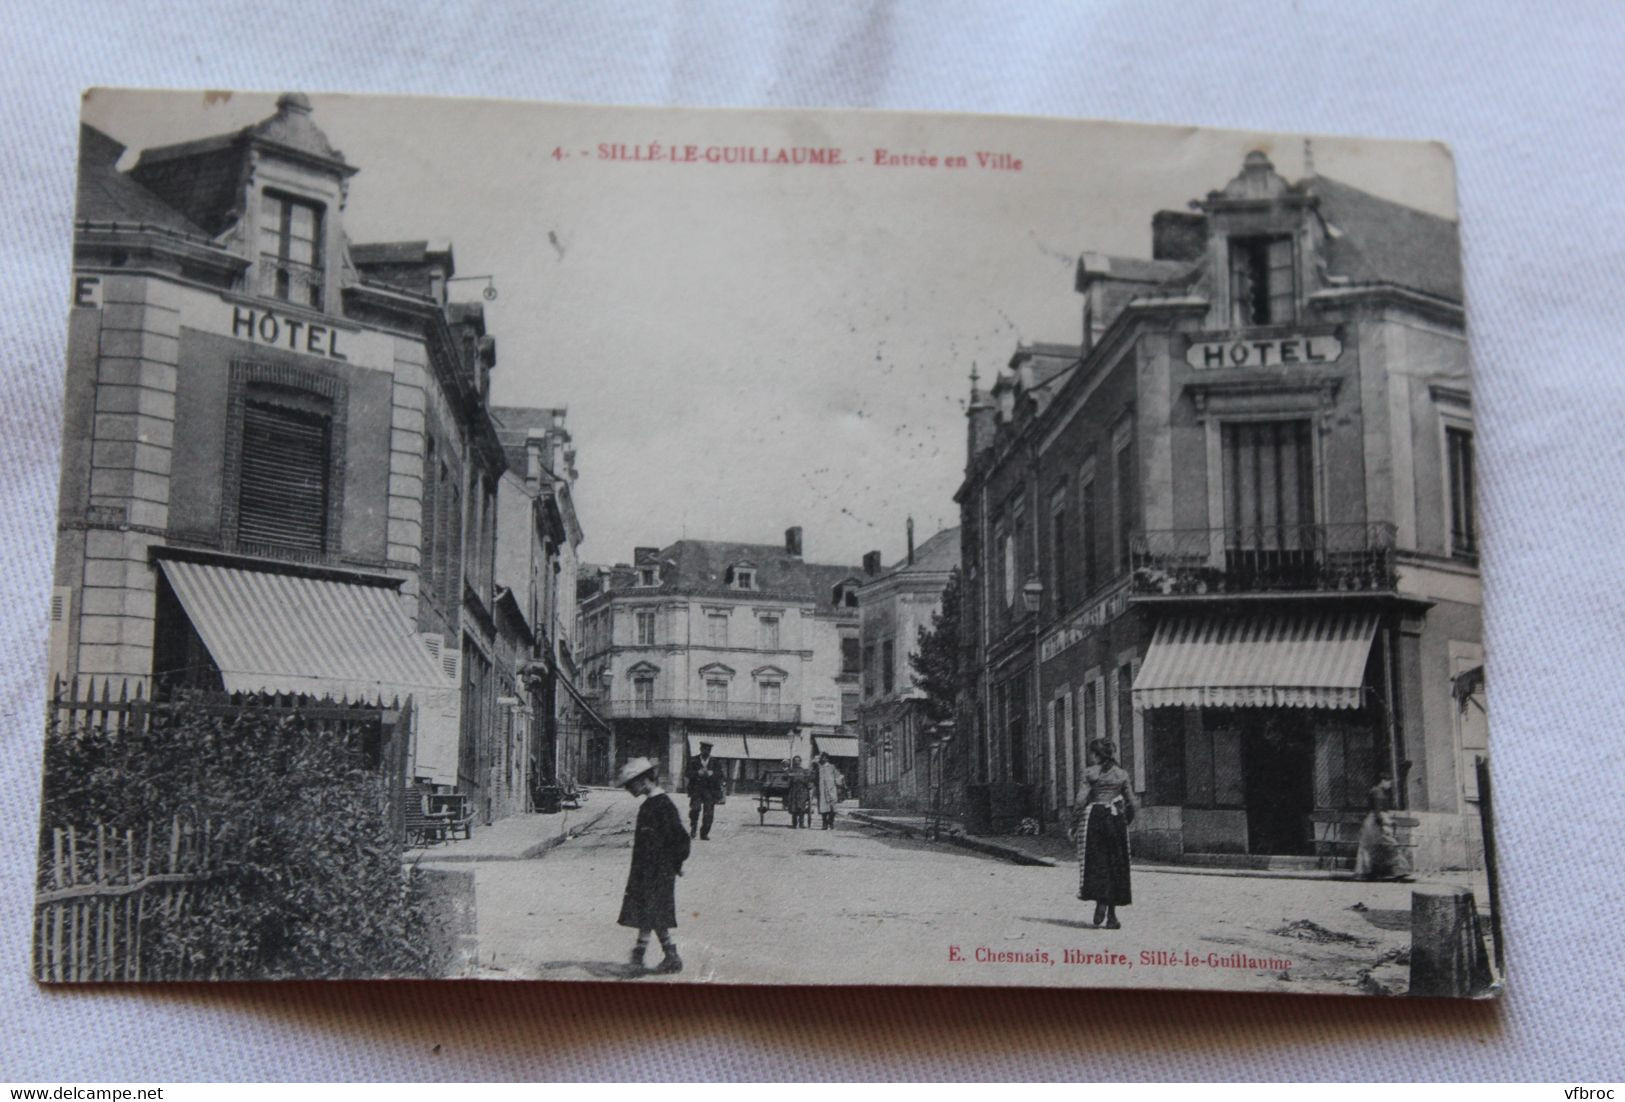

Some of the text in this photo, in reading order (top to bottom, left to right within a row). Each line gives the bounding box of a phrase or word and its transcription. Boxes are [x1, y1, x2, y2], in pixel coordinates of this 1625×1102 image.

[873, 147, 938, 168] Entrée
[944, 155, 968, 168] en
[976, 151, 1023, 171] Ville
[232, 306, 347, 361] HÔTEL
[949, 945, 1292, 970] E. Chesnais, libraire, Sillé-le-Guillaume
